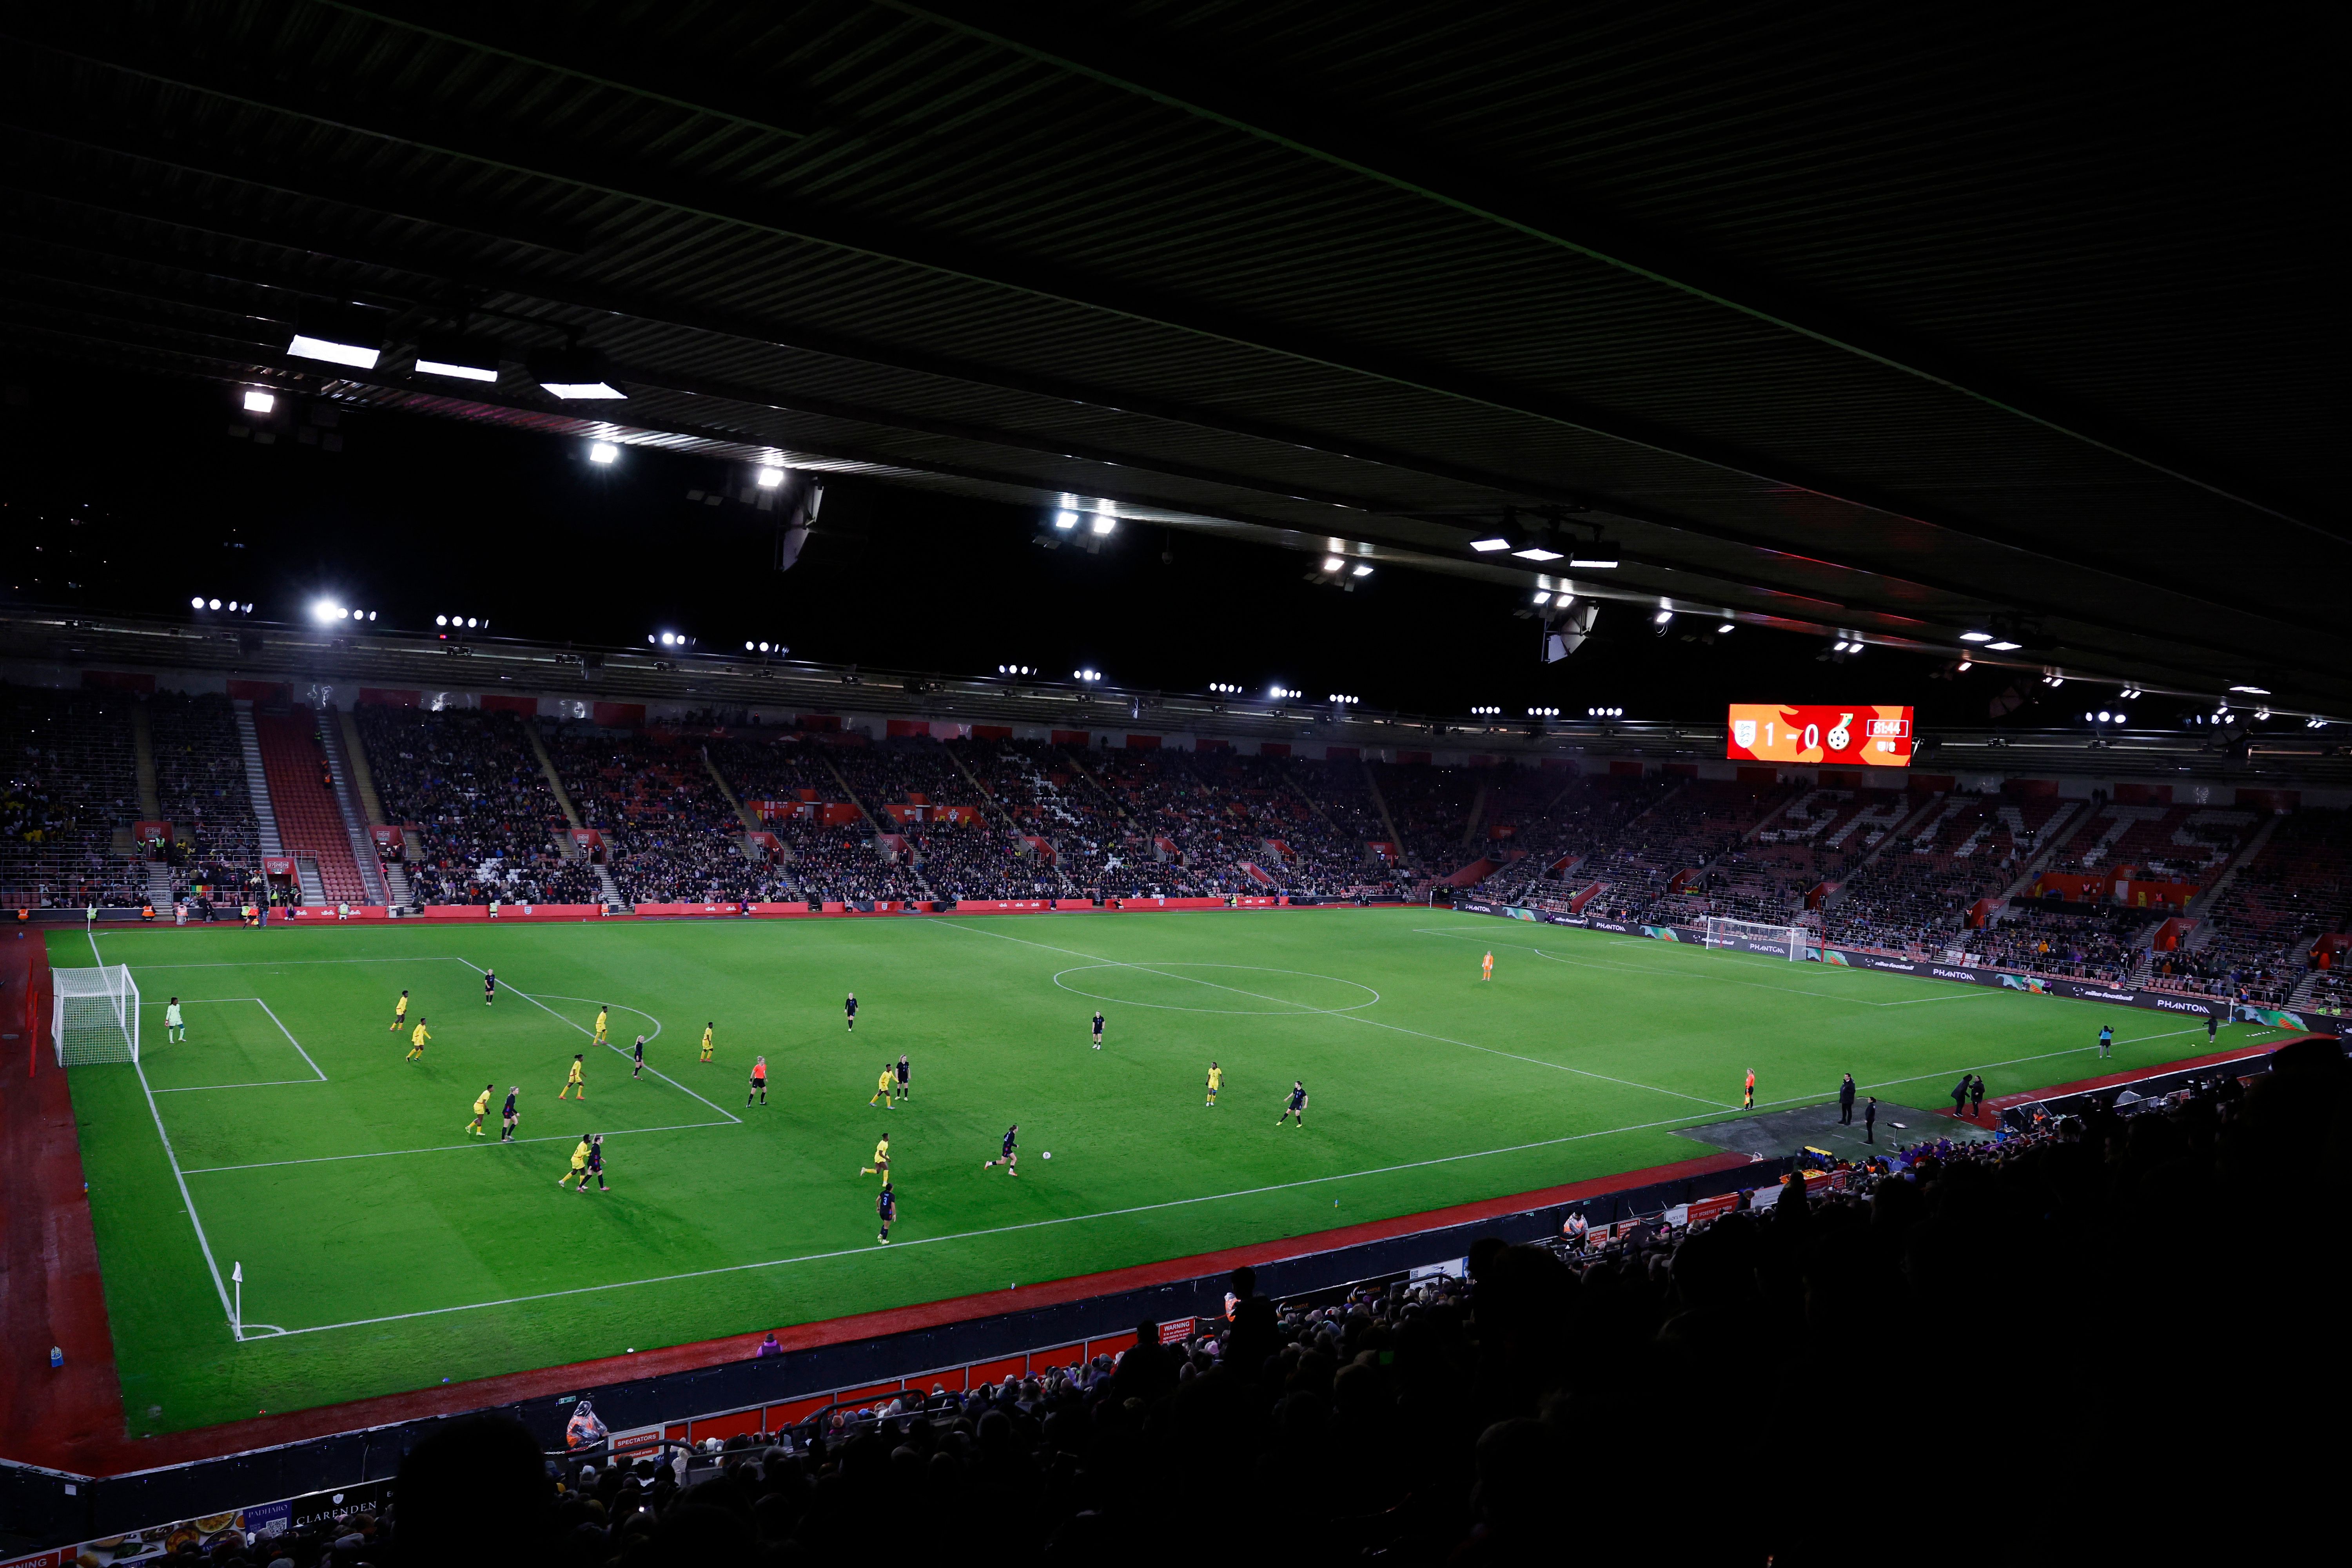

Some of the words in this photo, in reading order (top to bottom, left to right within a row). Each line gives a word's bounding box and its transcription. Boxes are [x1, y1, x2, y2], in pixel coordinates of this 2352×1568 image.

[1873, 722, 1900, 734] 81:44
[1765, 722, 1773, 746] 1
[1805, 724, 1818, 749] 0
[1465, 904, 1491, 913] PHANTOM
[1597, 922, 1626, 931] PHANTOM
[1750, 943, 1785, 954] PHANTOM
[1933, 969, 1975, 980] PHANTOM
[2102, 992, 2134, 1001] football
[2157, 1000, 2210, 1014] PHANTOM
[883, 1197, 887, 1206] 3
[1164, 1321, 1190, 1332] WARNING
[617, 1434, 656, 1446] SPECTATORS
[296, 1501, 377, 1525] CLARENDEN
